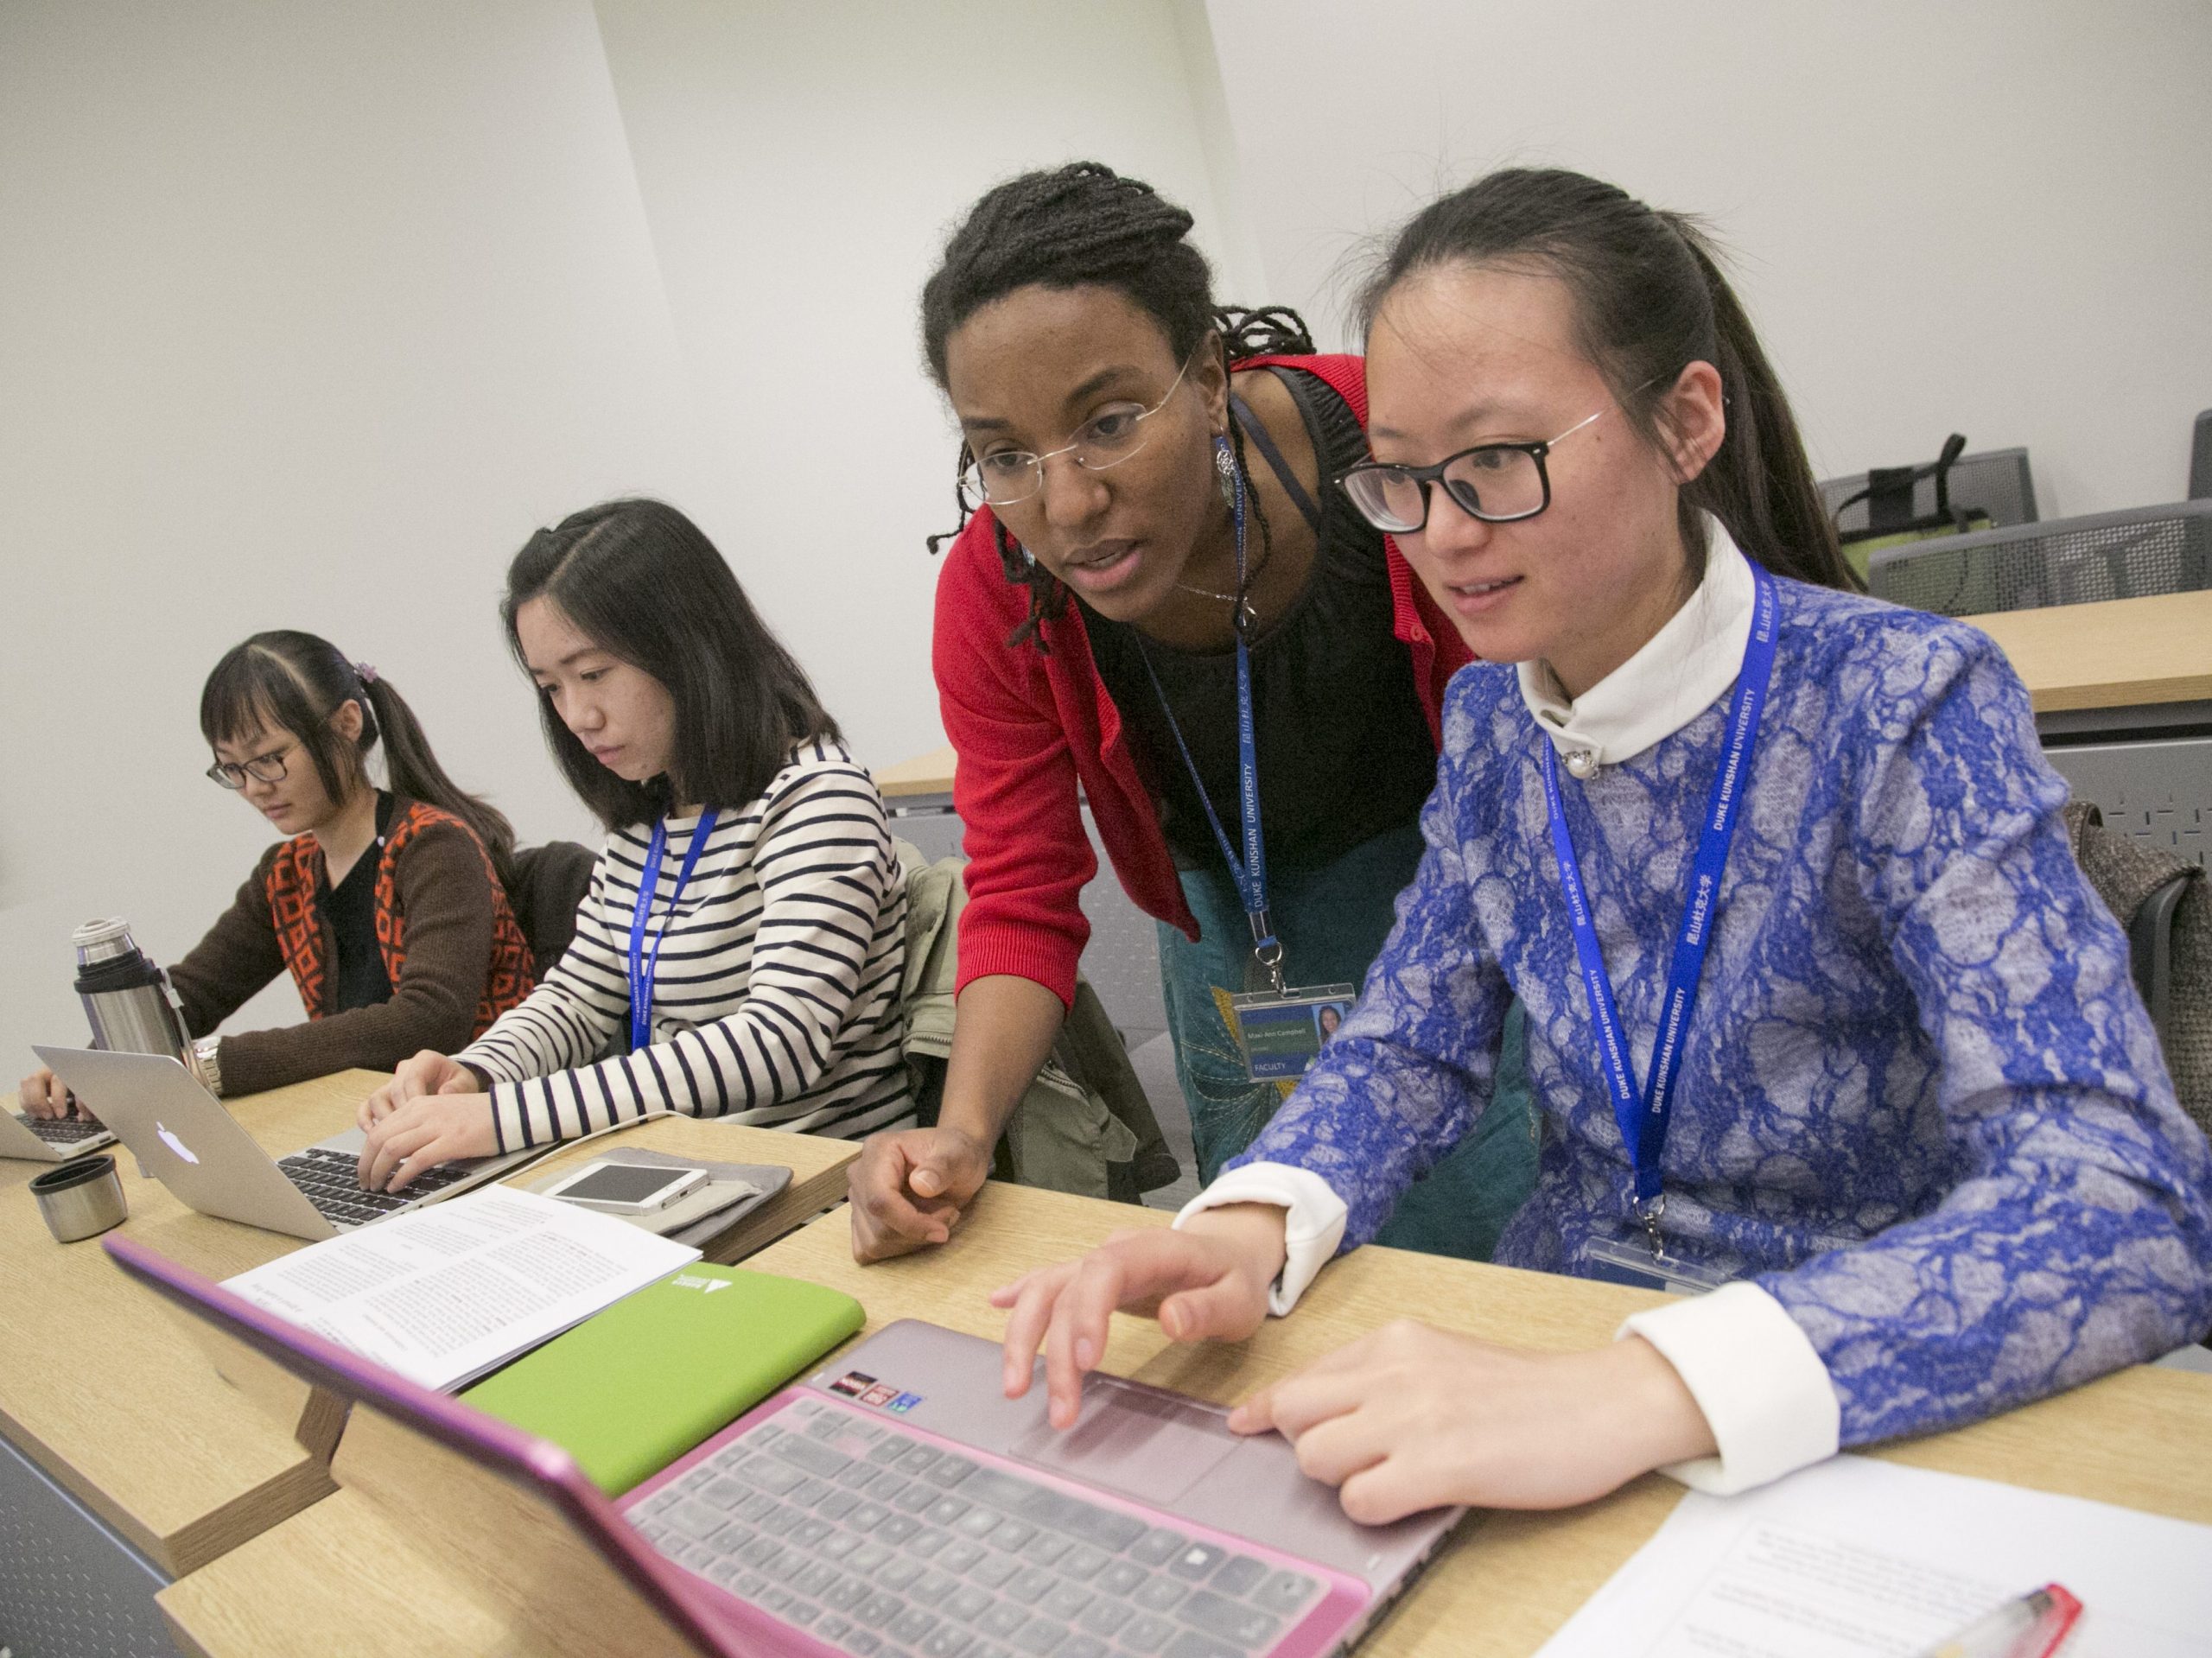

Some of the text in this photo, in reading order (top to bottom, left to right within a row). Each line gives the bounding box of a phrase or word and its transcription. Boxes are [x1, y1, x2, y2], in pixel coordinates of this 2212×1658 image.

[1549, 795, 1559, 820] DUKE
[1713, 688, 1756, 831] DUKE KUNSHAN UNIVERSITY
[1244, 764, 1263, 908] DUKE KUNSHAN UNIVERSITY
[1687, 874, 1712, 946] 昆山杜克大学
[1255, 1062, 1286, 1071] FACULTY
[1589, 969, 1630, 1100] DUKE KUNSHAN UNIVERSITY
[1652, 987, 1685, 1114] DUKE KUNSHAN UNIVERSITY
